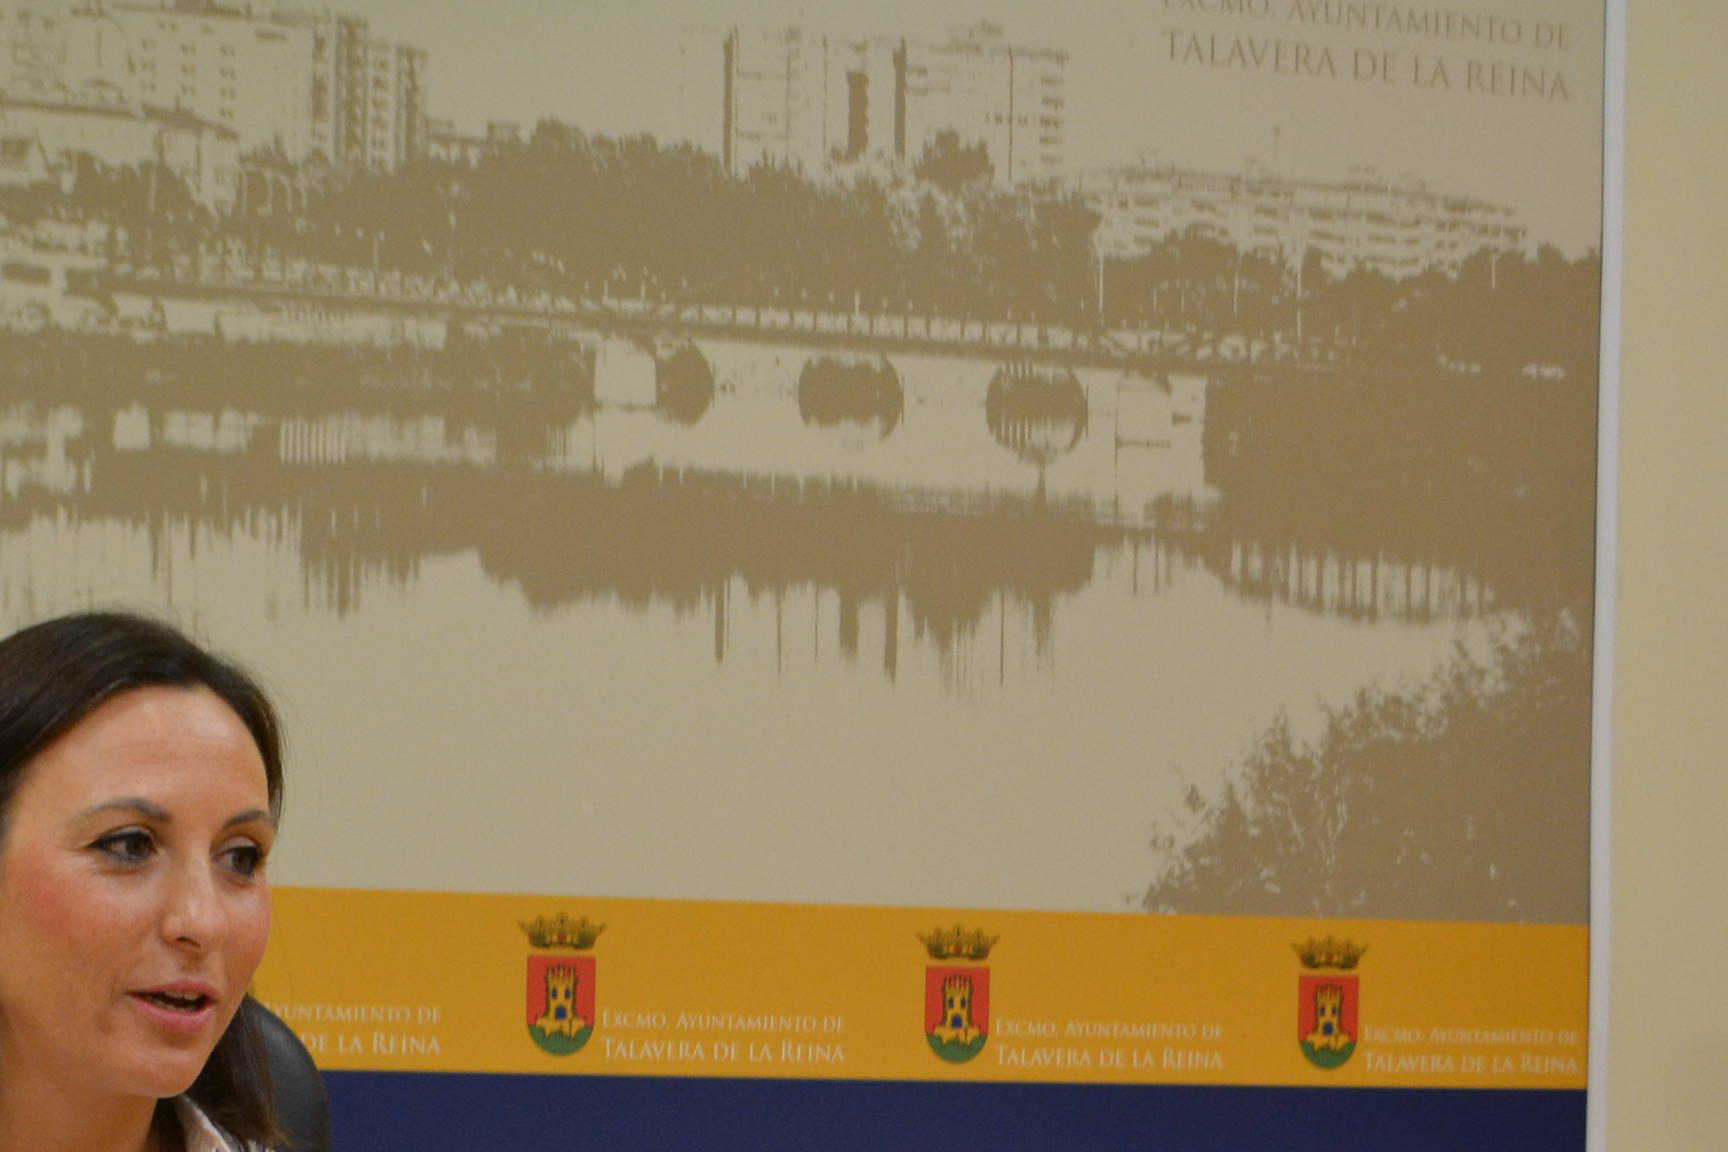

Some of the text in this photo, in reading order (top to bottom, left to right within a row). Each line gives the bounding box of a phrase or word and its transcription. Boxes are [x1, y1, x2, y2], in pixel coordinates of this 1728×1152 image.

[1288, 0, 1522, 45] AYUNTAMIENTO
[1535, 20, 1570, 50] DE
[1162, 27, 1571, 101] TALAVERA DE LA REINA
[417, 1006, 442, 1025] DE
[675, 1011, 818, 1033] AYUNTAMIENTO
[823, 1015, 845, 1033] DE
[1064, 1020, 1197, 1041] AYUNTAMIENTO
[1202, 1023, 1223, 1041] DE
[338, 1033, 365, 1056] LA
[372, 1031, 442, 1057] REINA
[603, 1035, 846, 1065] TALAVERA DE LA REINA
[995, 1043, 1223, 1071] TALAVERA DE LA REINA
[1365, 1050, 1580, 1076] TALAVERA DE LA REINA
